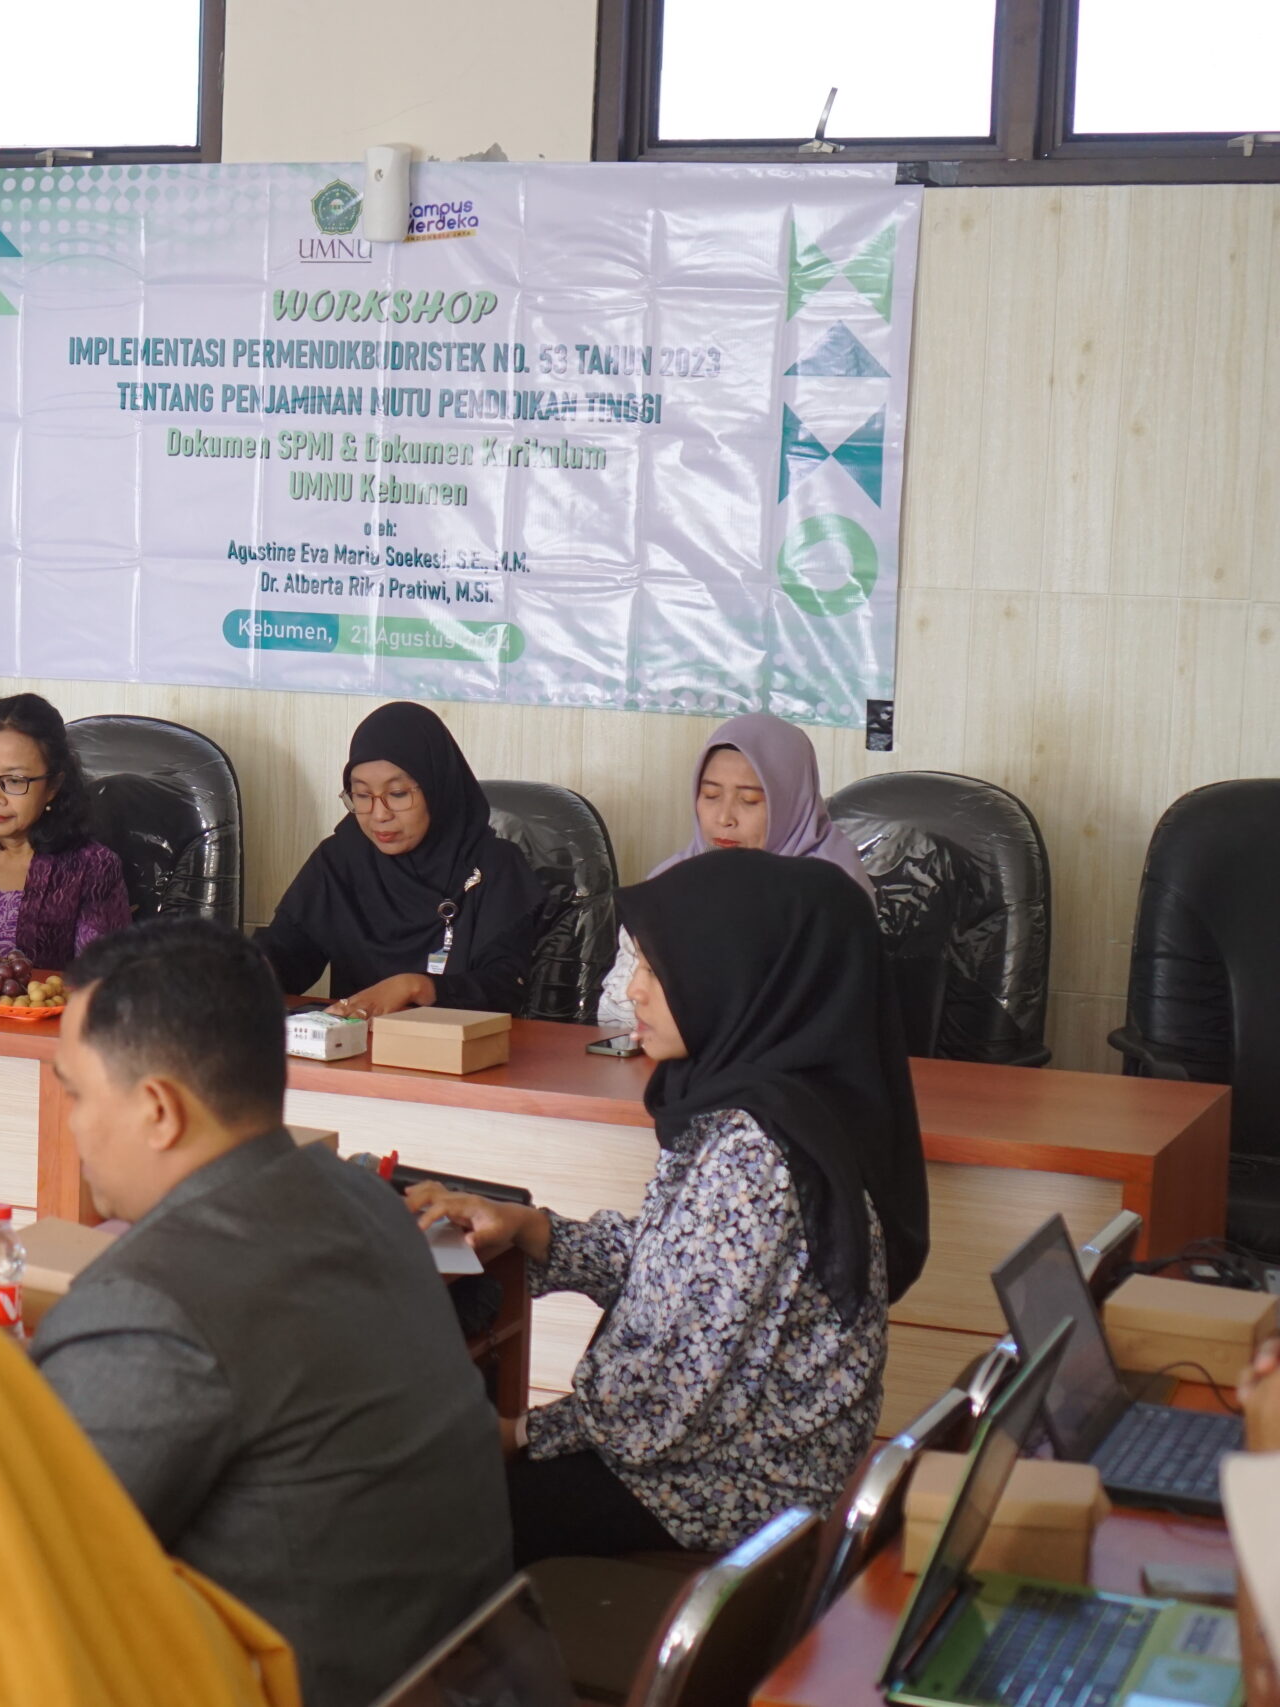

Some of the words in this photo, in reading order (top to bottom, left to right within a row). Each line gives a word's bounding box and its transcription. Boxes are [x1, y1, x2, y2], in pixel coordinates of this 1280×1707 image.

[409, 200, 474, 219] ampus
[298, 237, 373, 260] UMNU
[272, 287, 498, 325] WORKSHOP
[68, 336, 226, 368] IMPLEMENTASI
[232, 338, 487, 373] PERMENDIKBUDRISTEK
[493, 342, 531, 374] NO.
[538, 343, 569, 375] 53
[574, 344, 653, 376] TAHUN
[659, 346, 721, 378] 2023
[117, 381, 214, 412] TENTANG
[220, 383, 363, 416] PENJAMINAN
[370, 386, 432, 417] MUTU
[438, 388, 578, 421] PENDIDIKAN
[586, 391, 662, 424] TINGGI
[167, 427, 270, 460] Dokumen
[278, 430, 333, 461] SPMI
[339, 432, 358, 463] &
[365, 432, 473, 467] Dokumen
[480, 434, 607, 470] Kurikulum
[288, 470, 353, 502] UMNU
[360, 472, 468, 506] Kebumen
[227, 540, 296, 565] Agustine
[300, 542, 329, 564] Eva
[334, 544, 380, 566] Maria
[494, 549, 531, 574] M.M.
[260, 572, 280, 593] Dr.
[283, 574, 344, 596] Alberta
[388, 577, 452, 605] Pratiwi,
[455, 581, 494, 604] M.Si.
[237, 618, 333, 644] Kebumen,
[351, 625, 369, 645] 21
[375, 627, 456, 651] Agustus
